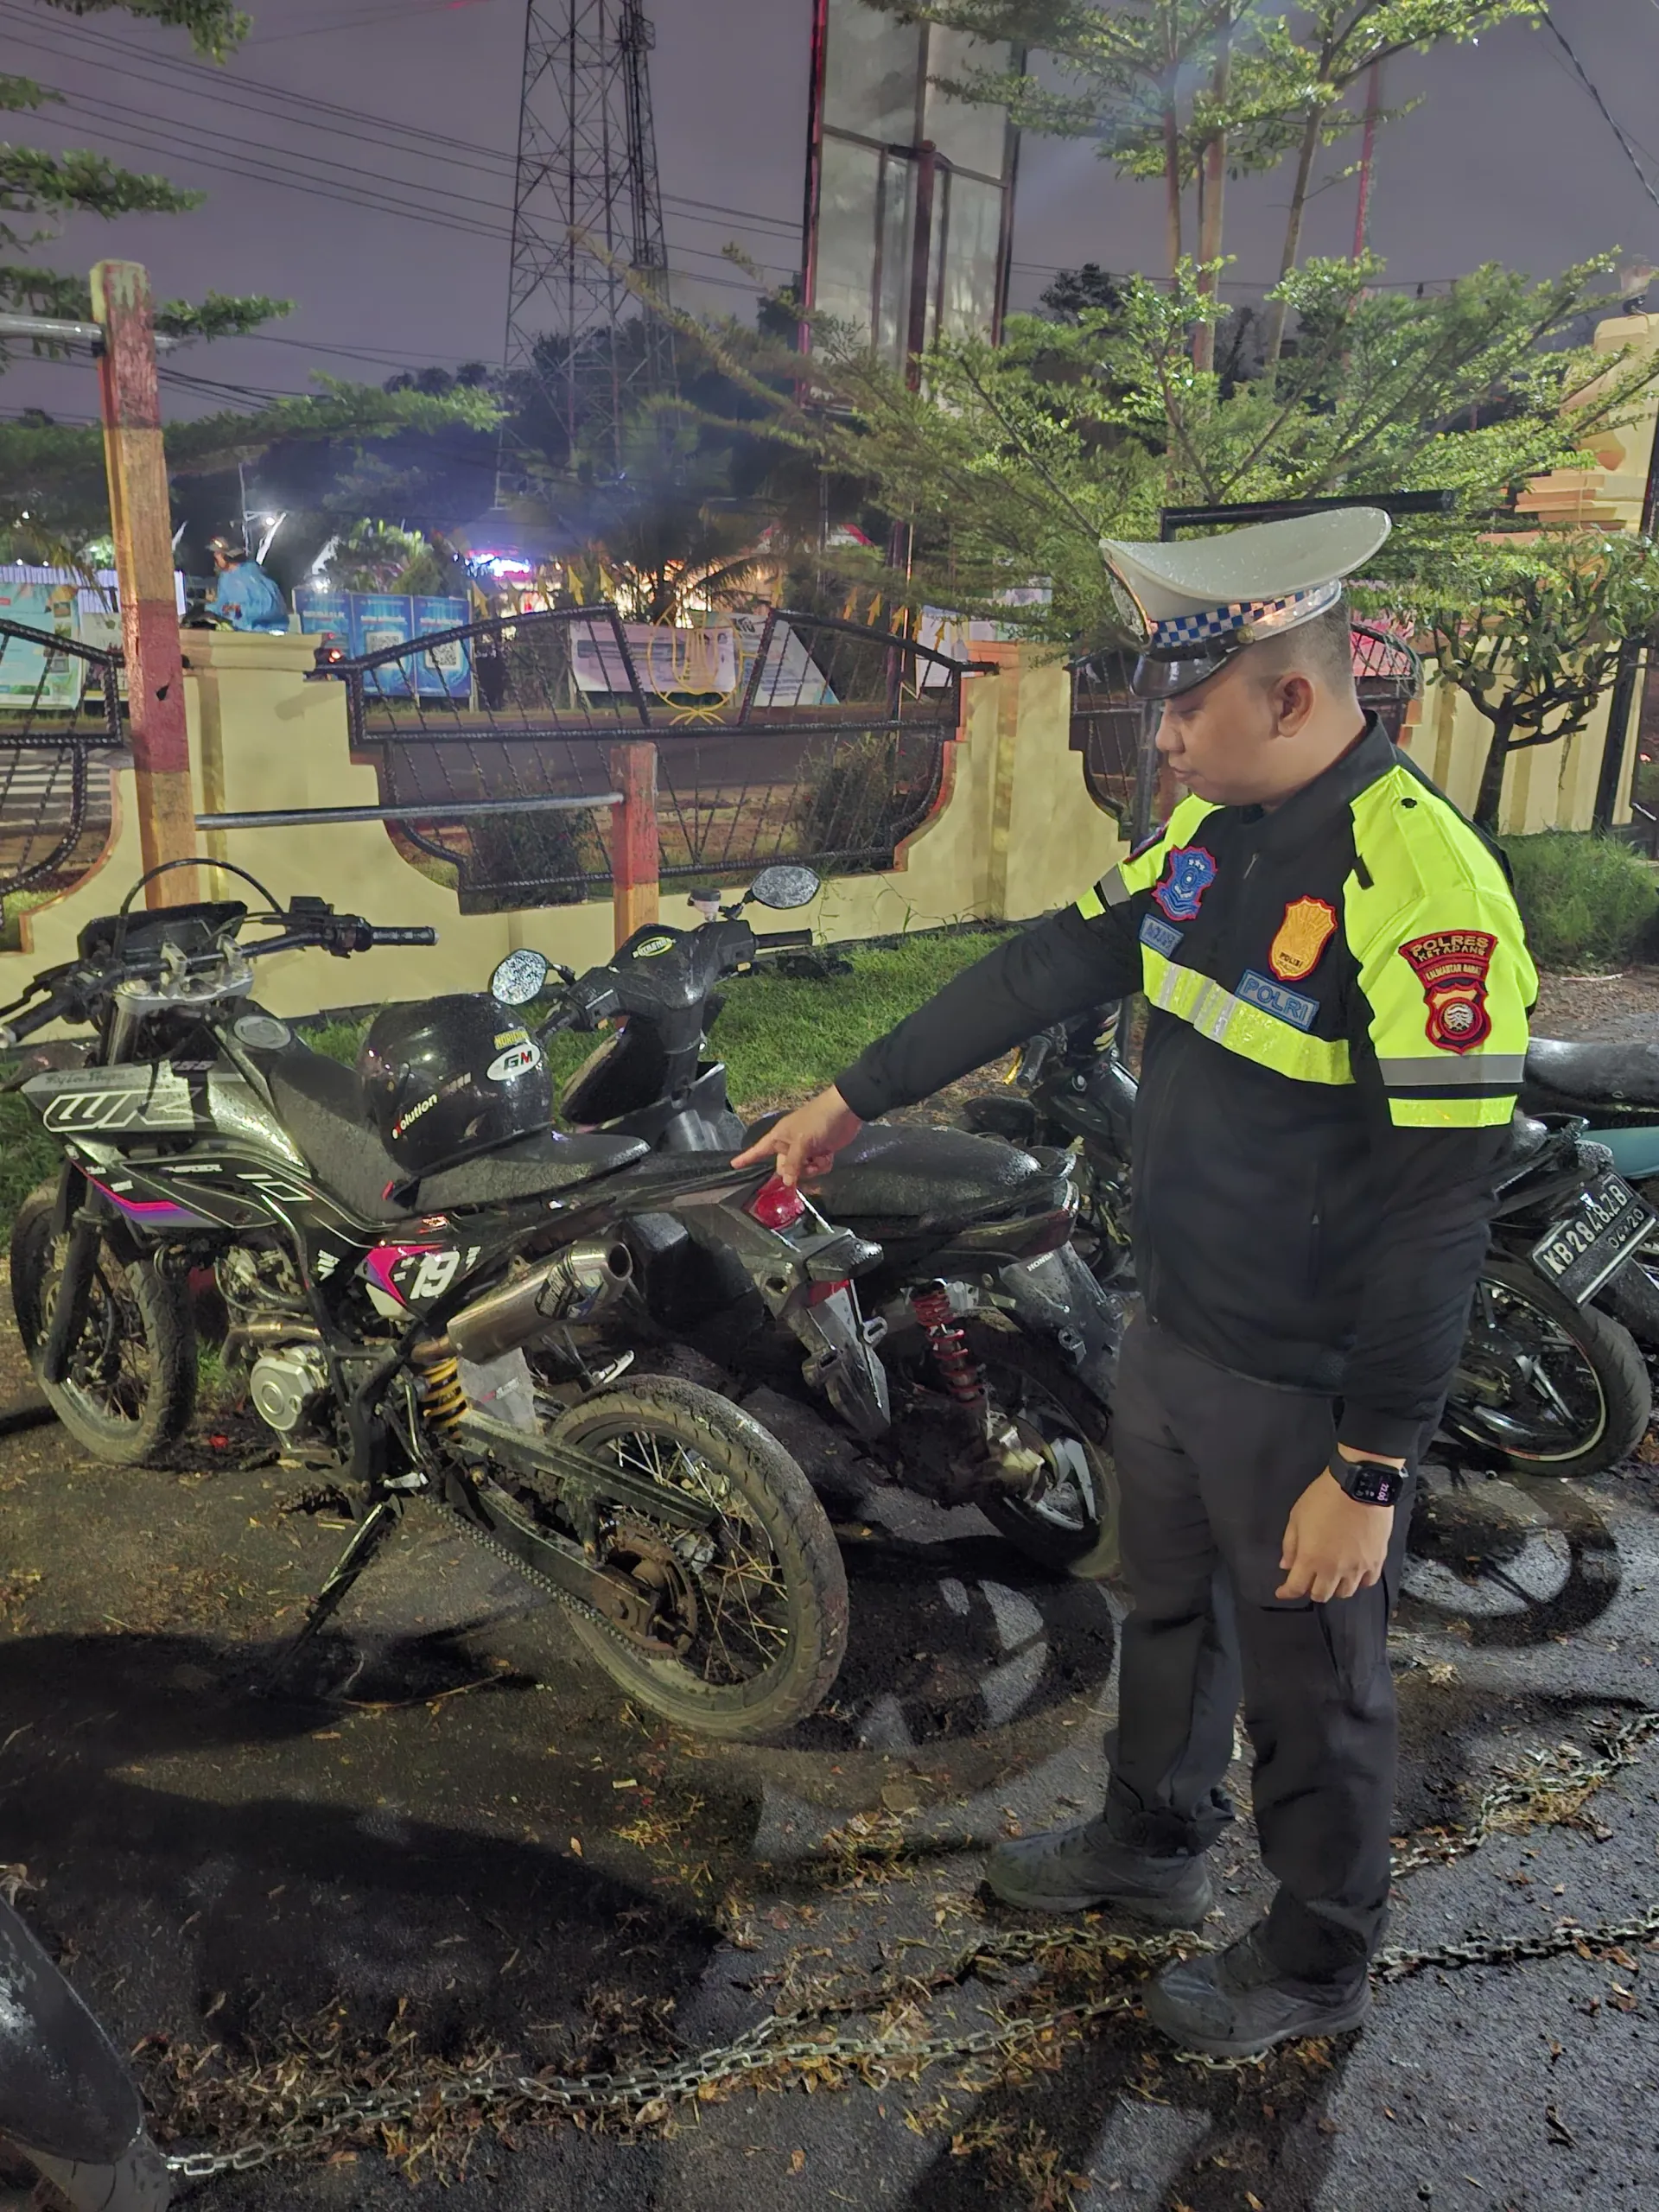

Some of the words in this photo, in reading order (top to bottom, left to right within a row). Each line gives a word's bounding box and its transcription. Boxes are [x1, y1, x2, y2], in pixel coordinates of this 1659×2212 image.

[1410, 935, 1489, 957] POLRES
[1418, 945, 1486, 962] KETAPANG
[1243, 977, 1308, 1021] POLRI
[504, 1050, 532, 1071] GM
[1542, 1242, 1574, 1275] KB
[1566, 1204, 1611, 1253] 2848
[1599, 1185, 1628, 1216] ZB
[1027, 1252, 1054, 1272] HONDA
[410, 1250, 461, 1300] 19
